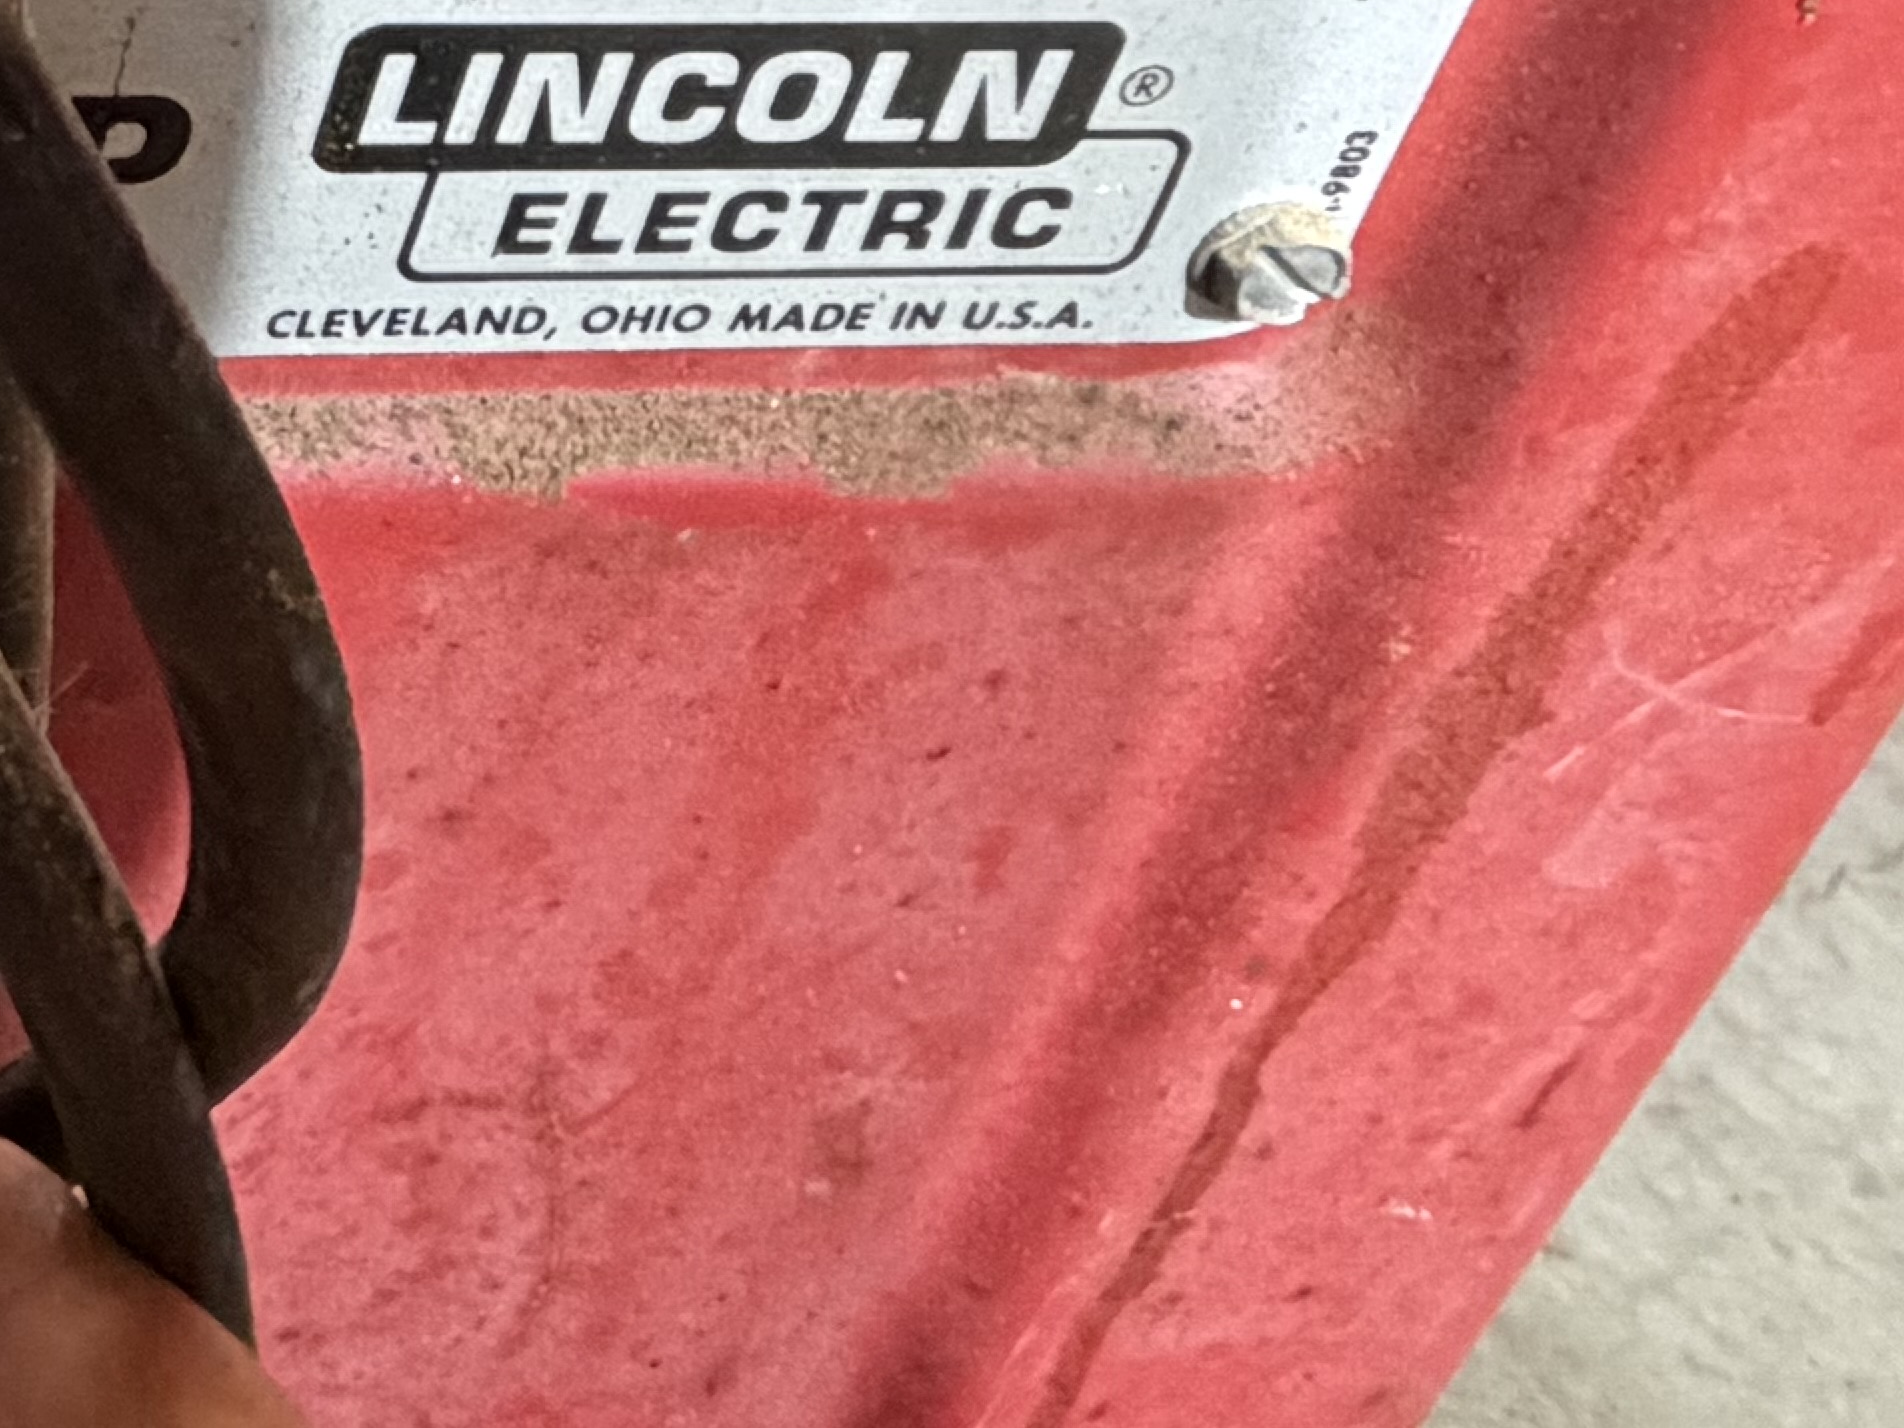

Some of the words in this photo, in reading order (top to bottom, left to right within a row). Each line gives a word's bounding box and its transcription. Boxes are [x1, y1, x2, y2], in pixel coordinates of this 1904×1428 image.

[357, 50, 1074, 145] LINCOLN
[495, 188, 1072, 256] ELECTRIC
[267, 306, 556, 340] CLEVELAND,
[581, 304, 711, 334] OHIO
[728, 303, 874, 331] MADE
[890, 302, 946, 330] IN
[963, 301, 1093, 330] U.S.A.
